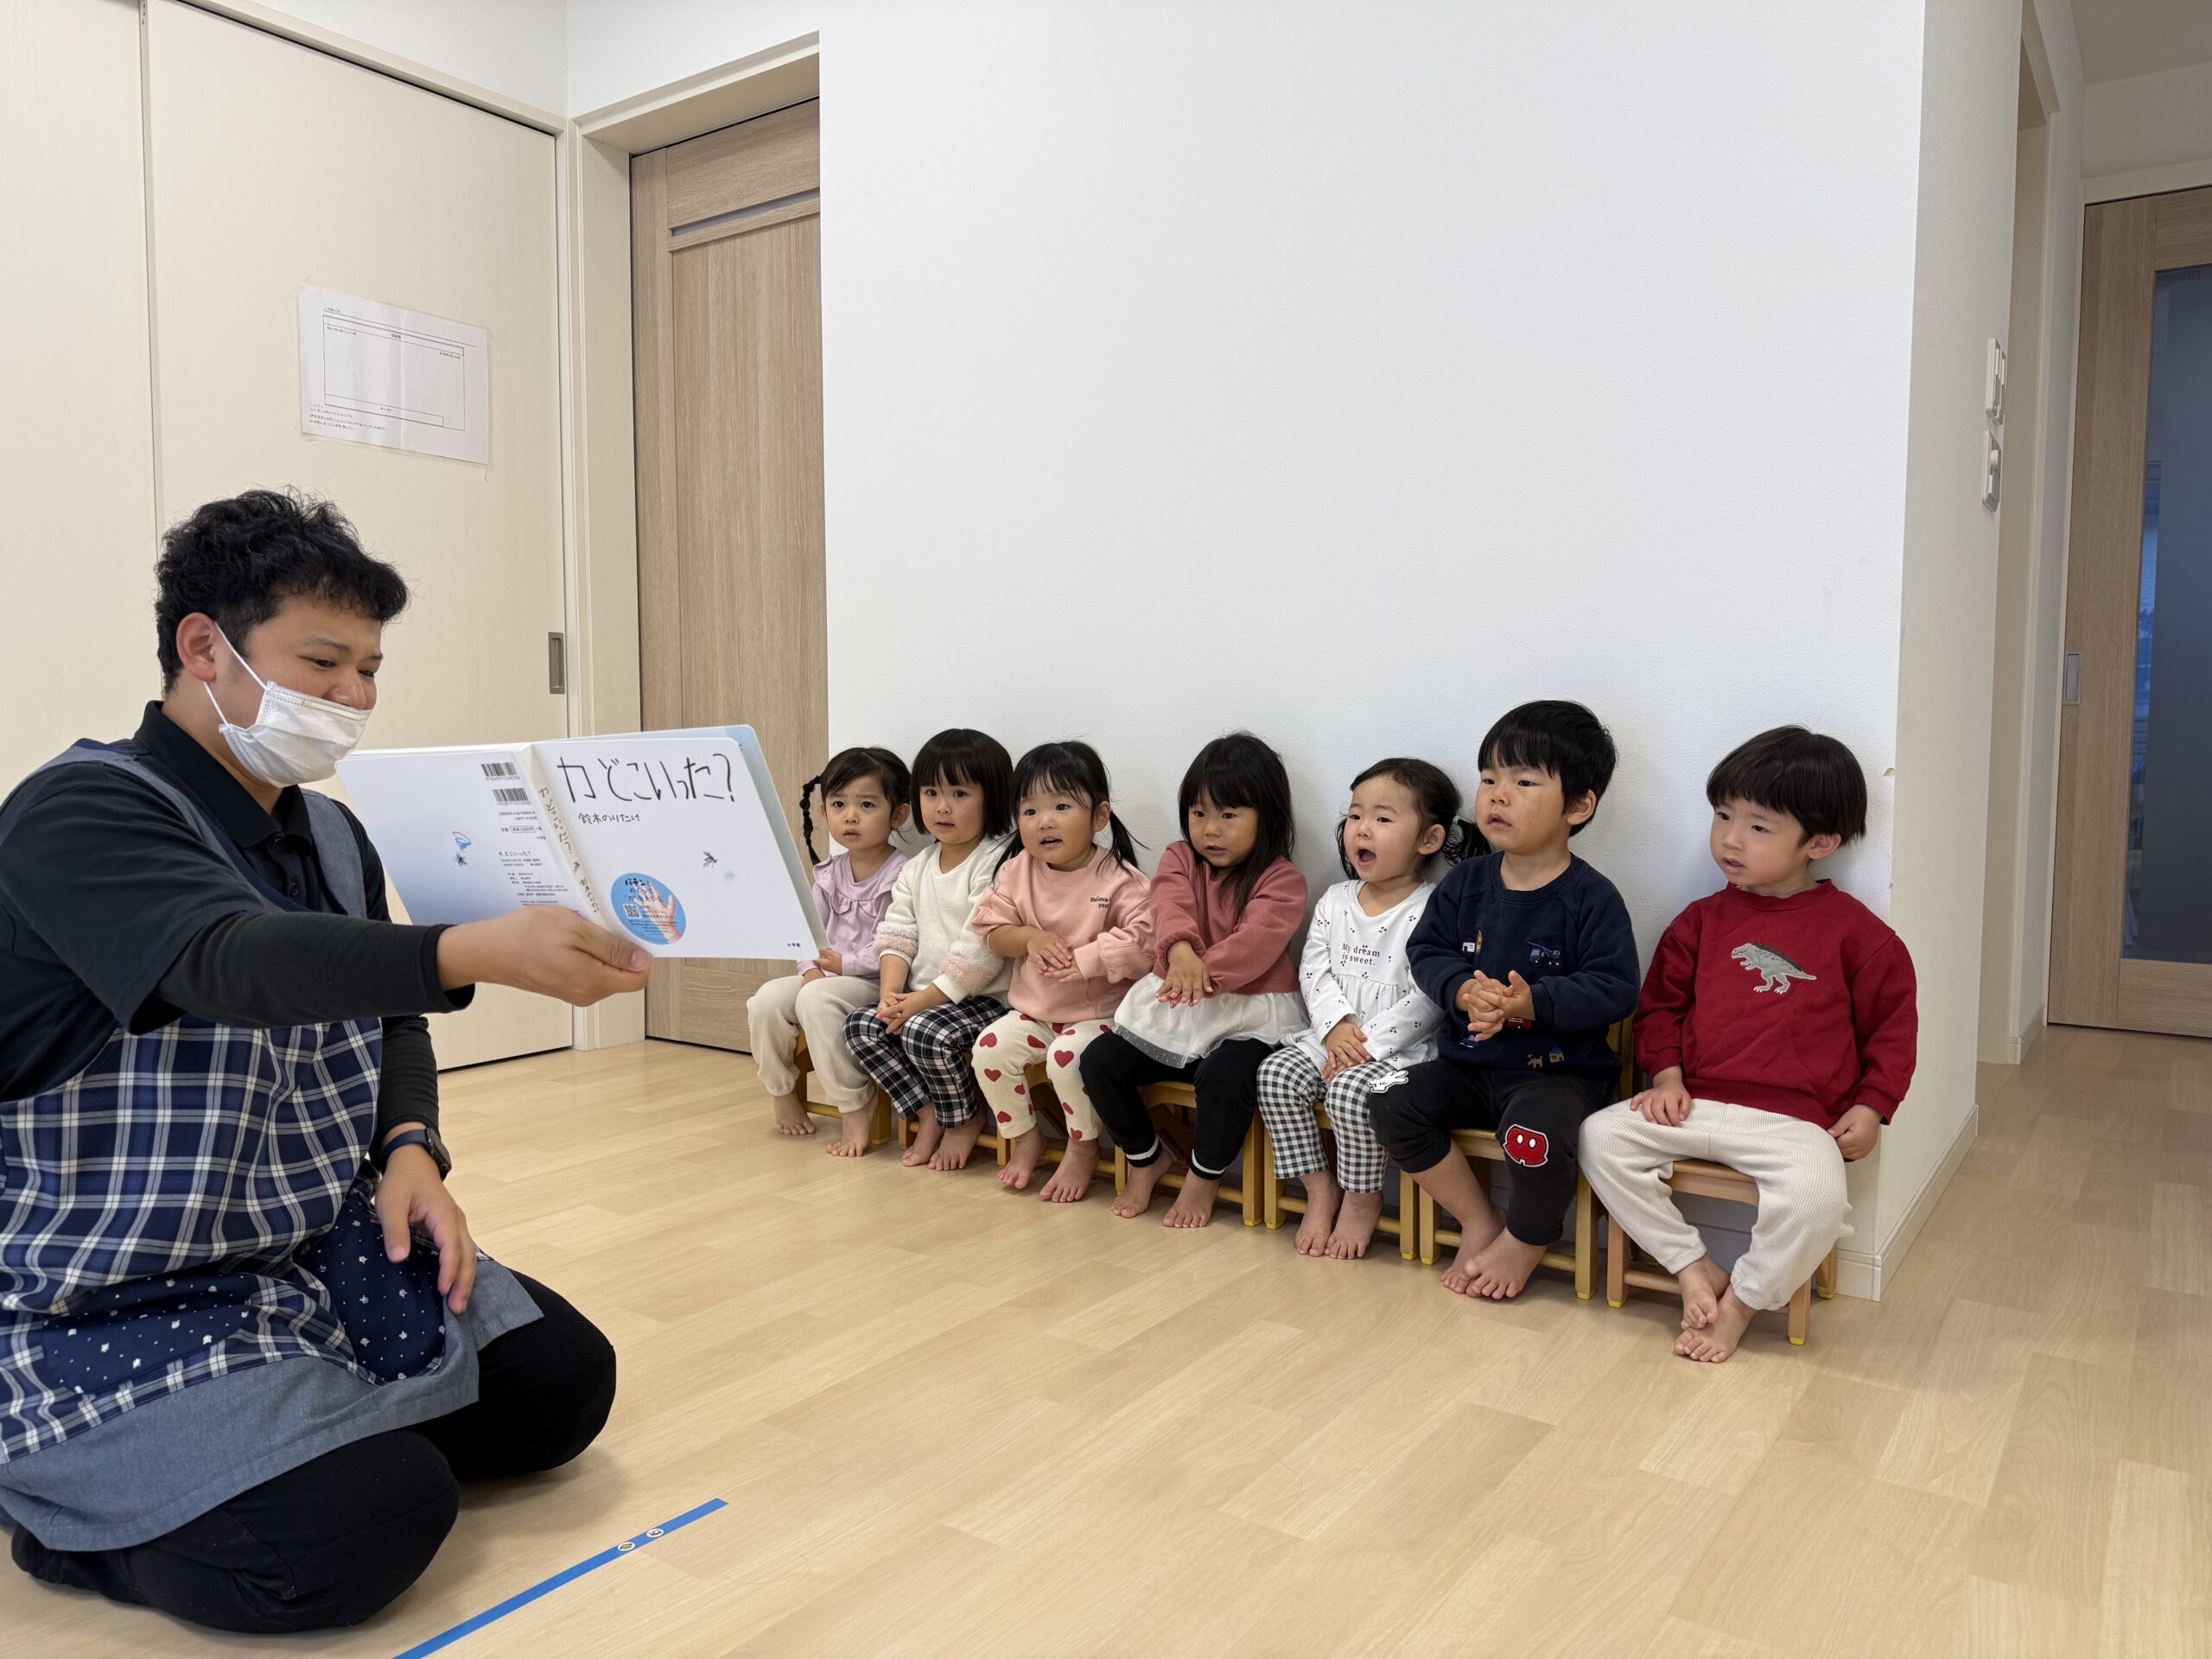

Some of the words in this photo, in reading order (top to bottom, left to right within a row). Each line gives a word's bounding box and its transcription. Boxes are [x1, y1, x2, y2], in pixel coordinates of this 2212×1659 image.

[578, 812, 640, 824] 鈴木のりたけ
[1341, 943, 1351, 954] My
[1353, 945, 1380, 957] dream
[1342, 951, 1349, 960] is
[1349, 955, 1376, 966] sweet.
